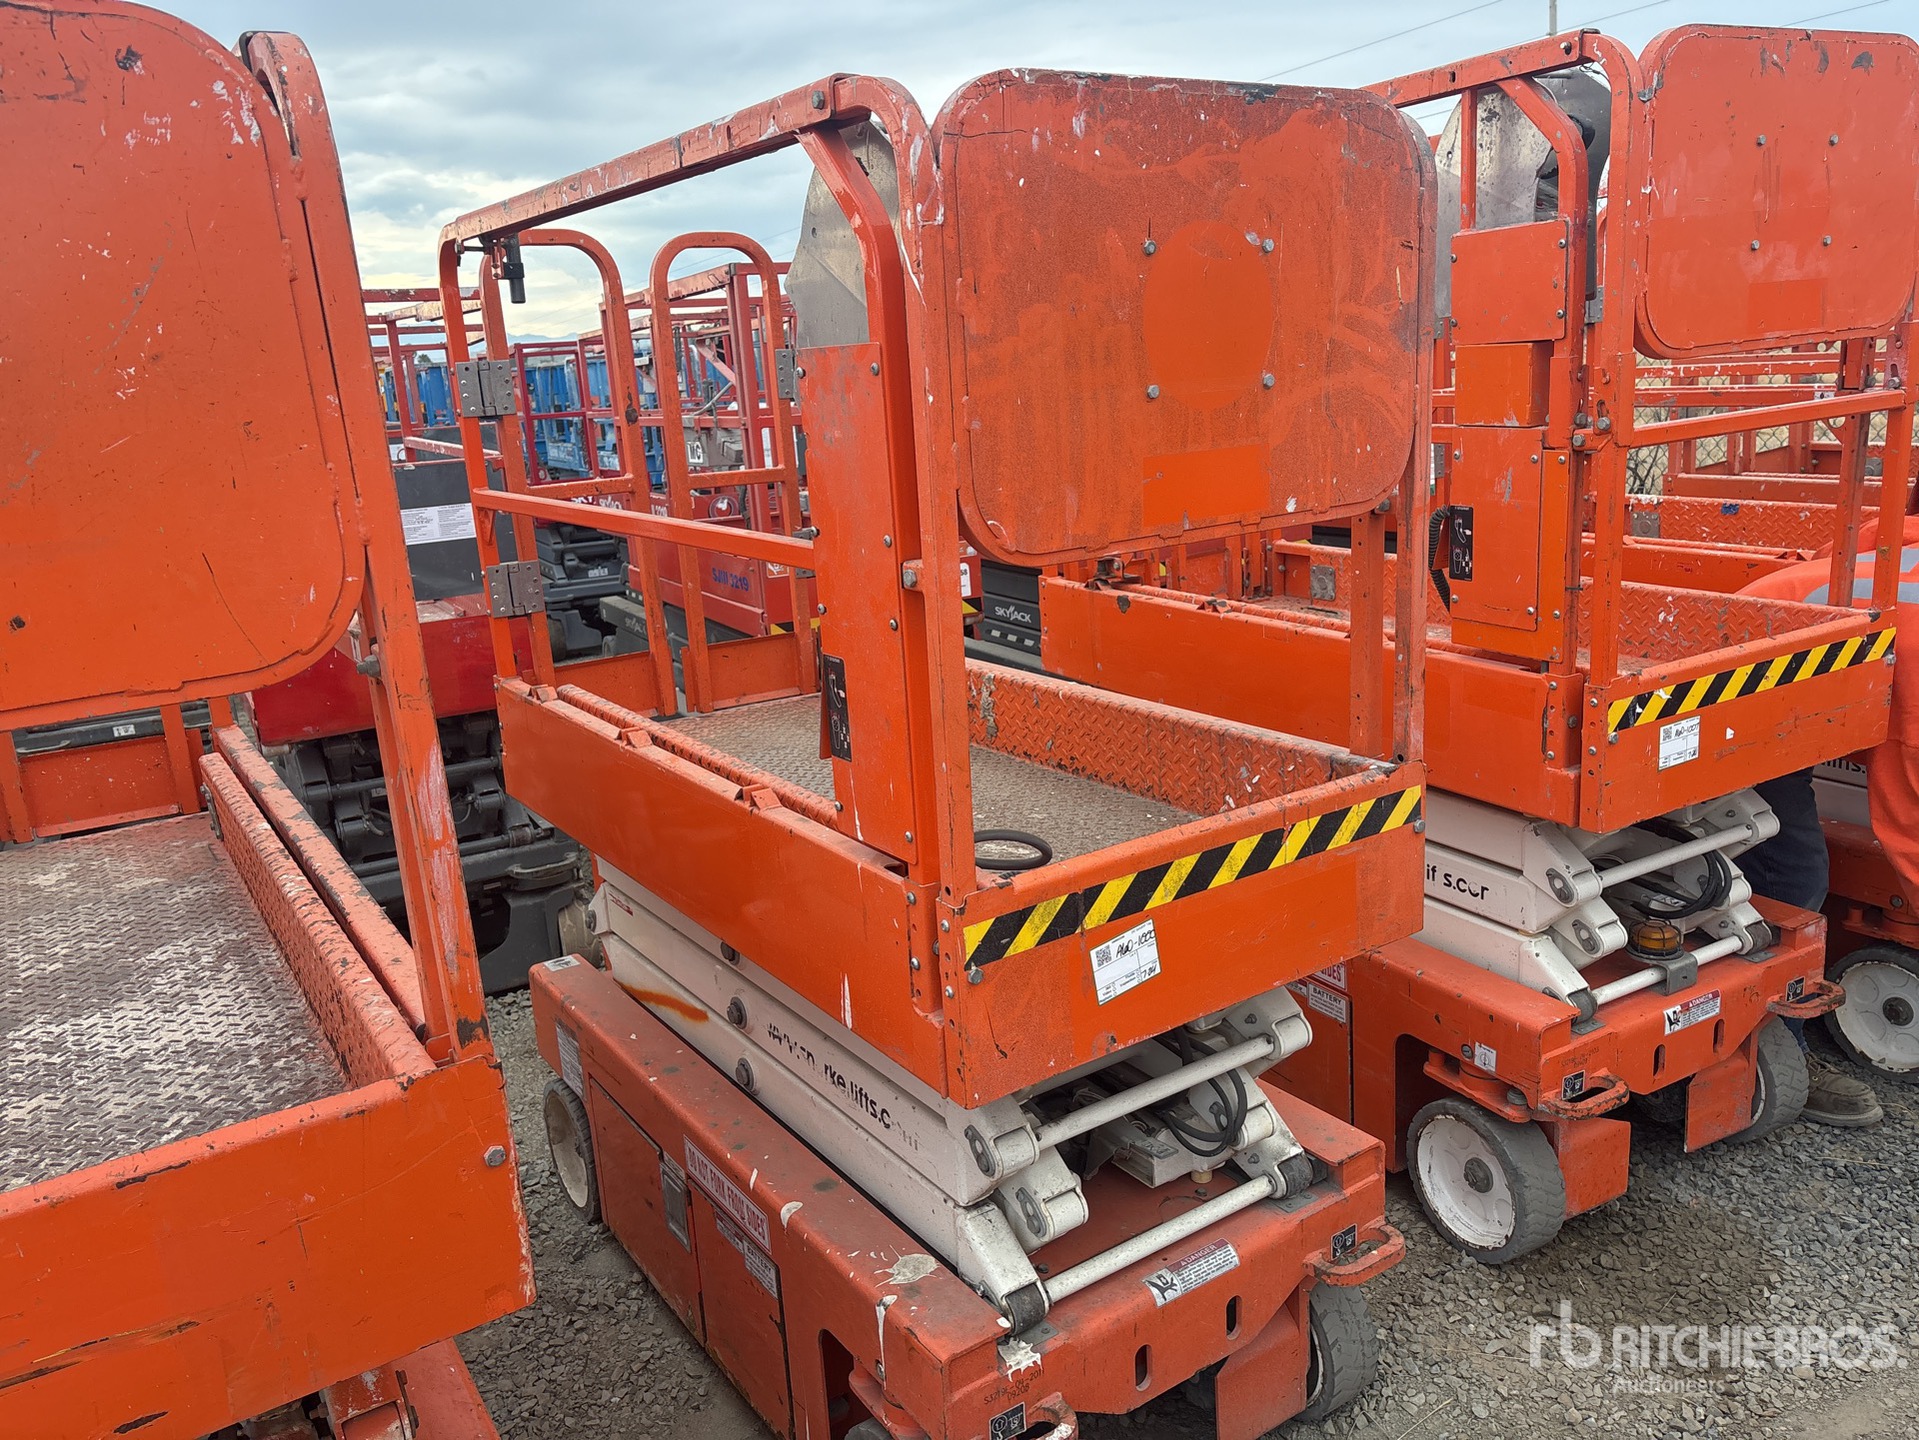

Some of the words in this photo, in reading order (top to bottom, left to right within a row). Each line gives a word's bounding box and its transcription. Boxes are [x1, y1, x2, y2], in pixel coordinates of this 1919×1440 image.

[994, 605, 1032, 623] SKYJACK
[1312, 987, 1342, 1006] BATTERY
[687, 1147, 697, 1173] DO
[697, 1154, 710, 1185] NOT
[709, 1167, 727, 1202] FORK
[727, 1185, 746, 1220] FROM
[746, 1203, 766, 1242] SIDES
[746, 1245, 772, 1275] BATTERY
[1185, 1244, 1218, 1263] DANGER
